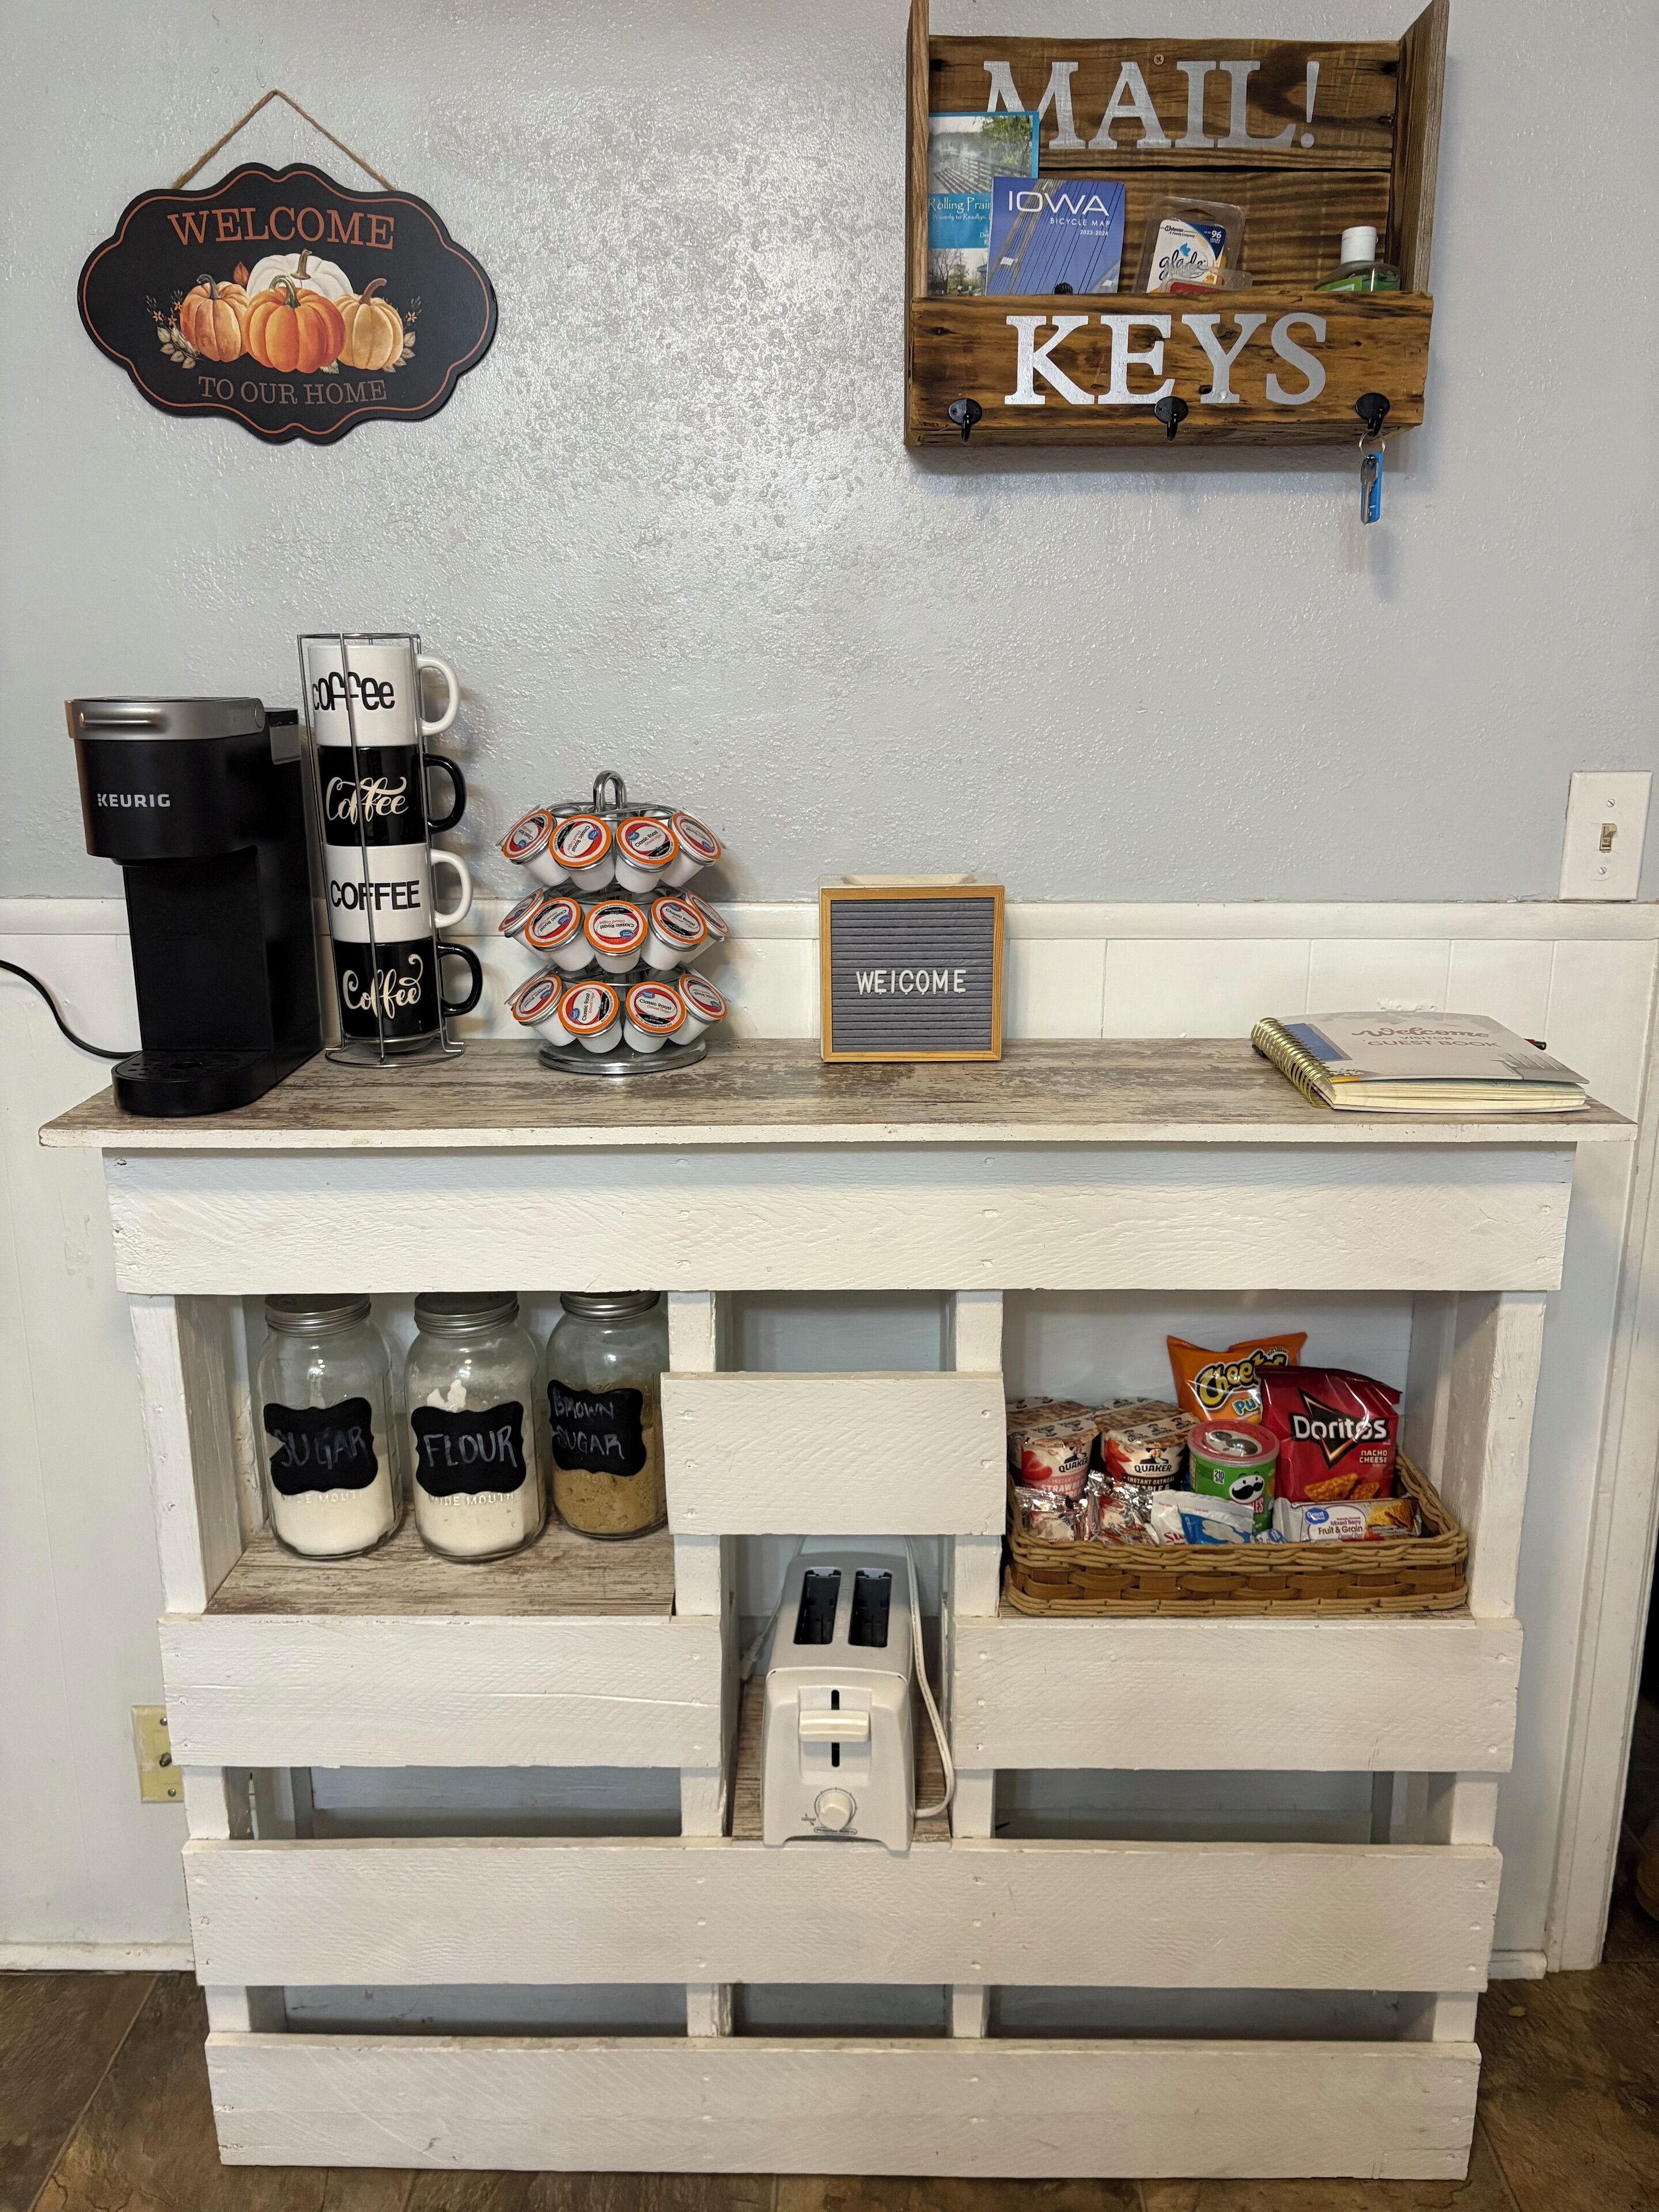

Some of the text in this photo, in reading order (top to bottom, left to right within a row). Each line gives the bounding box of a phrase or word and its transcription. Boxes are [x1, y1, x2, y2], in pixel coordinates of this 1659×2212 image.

[984, 60, 1319, 149] MAIL!
[928, 197, 964, 214] Rolling
[1009, 191, 1109, 216] IOWA
[167, 206, 394, 249] WELCOME
[1050, 217, 1087, 226] BICYCLE
[1211, 230, 1222, 238] 96
[1005, 313, 1326, 405] KEYS
[198, 376, 387, 404] TO OUR HOME
[312, 672, 395, 710] coffee
[97, 793, 171, 808] KEURIG
[325, 777, 409, 825] Coffee
[635, 830, 658, 847] Classic Roast
[331, 880, 421, 910] COFFEE
[343, 953, 423, 1019] Coffee
[639, 999, 657, 1007] Classic
[1352, 1028, 1489, 1037] Welcome
[552, 1386, 615, 1419] BROWN
[1293, 1415, 1387, 1440] Doritos
[274, 1426, 369, 1469] SUGAR
[423, 1425, 517, 1467] FLOUR
[556, 1425, 624, 1459] SUGAR
[1059, 1457, 1088, 1472] QUAKER
[1134, 1464, 1172, 1472] QUAKER
[1214, 1469, 1224, 1480] 210
[1127, 1476, 1175, 1484] INSTANT OATMEAL
[1319, 1526, 1334, 1535] Fruit
[1342, 1524, 1363, 1533] Grain
